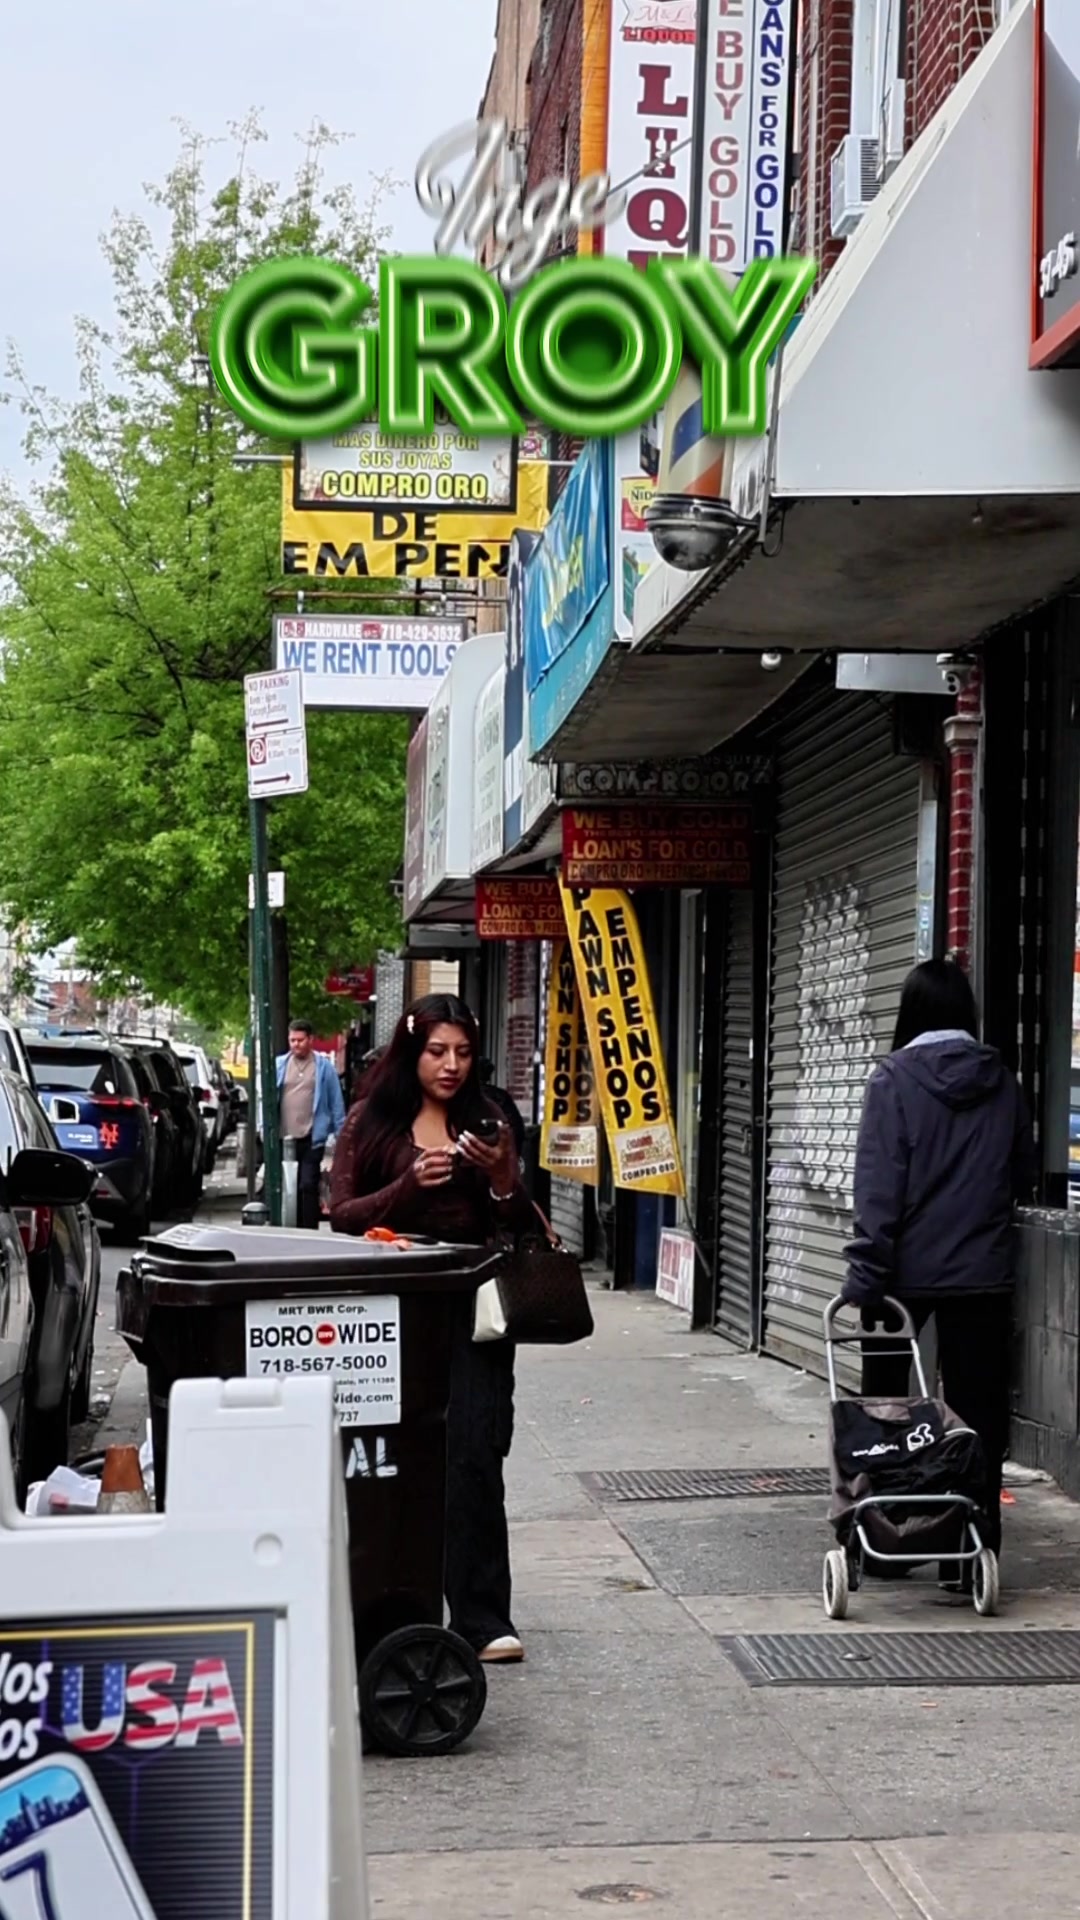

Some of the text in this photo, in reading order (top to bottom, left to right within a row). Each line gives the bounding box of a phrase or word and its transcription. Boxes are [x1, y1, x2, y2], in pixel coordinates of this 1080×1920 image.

[715, 31, 744, 121] BUY
[754, 0, 785, 260] AN'S FOR GOLD
[708, 135, 739, 263] GOLD
[443, 434, 480, 451] POR
[359, 450, 453, 471] SUS JOYAS
[321, 471, 489, 500] COMPRO ORO
[373, 512, 438, 541] DE
[304, 621, 361, 639] HARDWARE
[282, 640, 458, 677] WE RENT TOOLS
[249, 675, 290, 692] NO PARKING
[573, 810, 749, 829] WE BUY GOLD
[572, 839, 750, 861] LOAN'S FOR GOLD
[483, 881, 557, 897] WE BUY
[482, 903, 536, 919] LOAN'S
[570, 888, 633, 1129] PAWN SHOP
[605, 906, 662, 1122] EMPEÑOS
[552, 1023, 572, 1122] SHOP
[622, 1165, 657, 1182] COMPRO
[278, 1304, 368, 1316] MRT BWR Corp.
[250, 1325, 314, 1348] BORO
[337, 1322, 397, 1344] WIDE
[260, 1354, 388, 1374] 718-567-5000
[61, 1657, 244, 1750] USA
